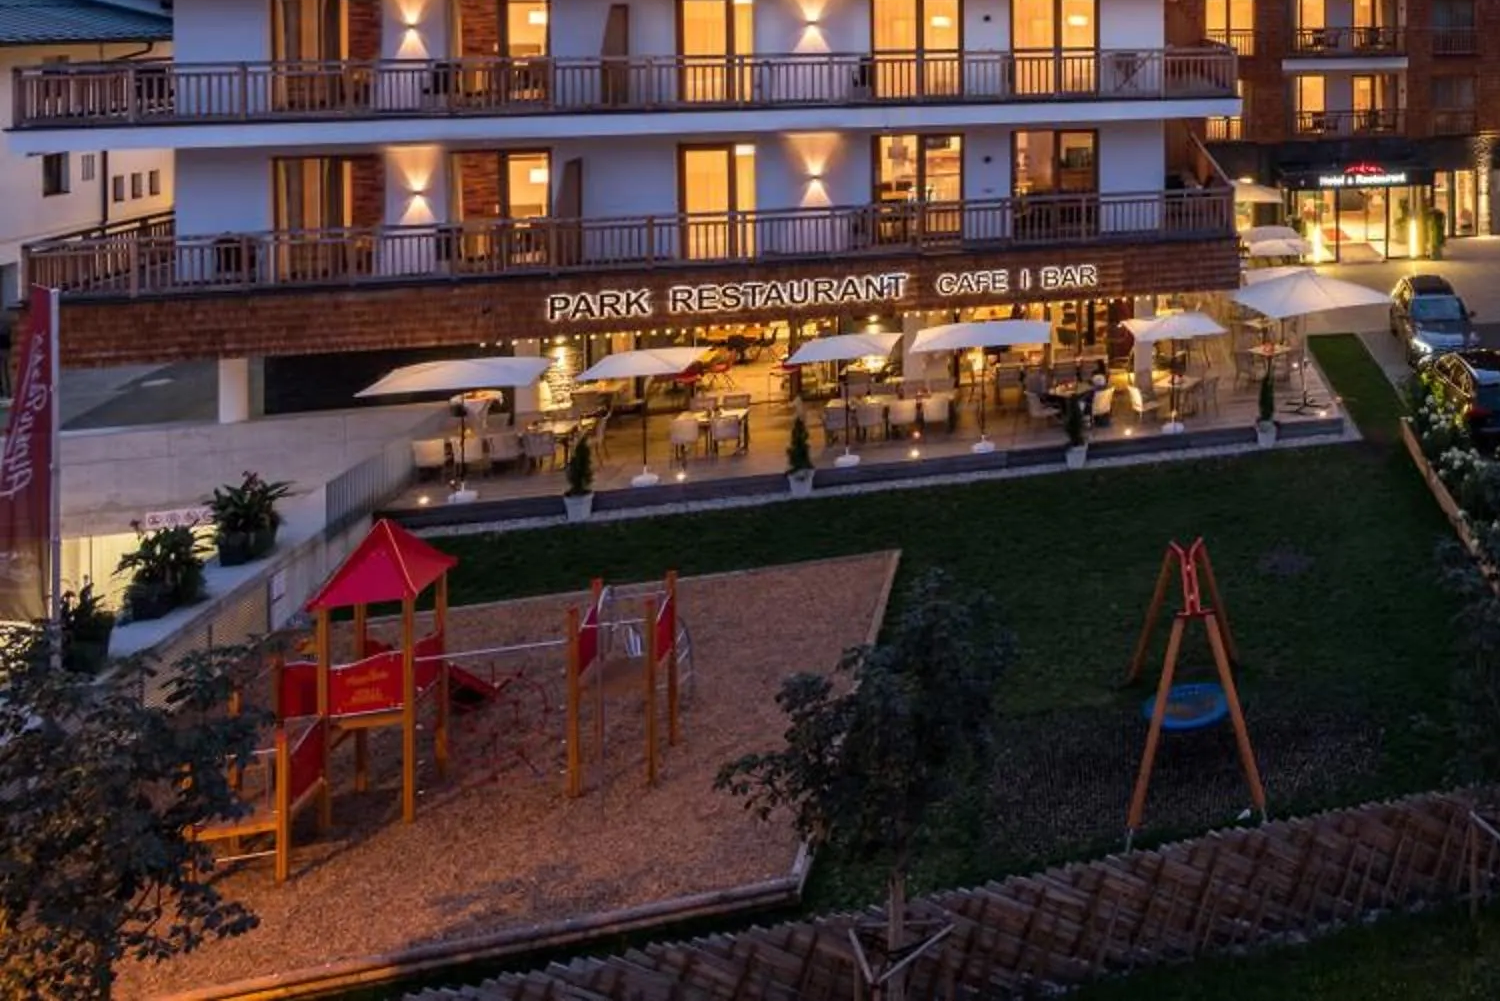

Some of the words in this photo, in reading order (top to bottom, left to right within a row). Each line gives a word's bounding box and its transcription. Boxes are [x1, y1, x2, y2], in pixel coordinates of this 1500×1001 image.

[548, 289, 650, 320] PARK
[670, 274, 909, 312] RESTAURANT
[937, 269, 1009, 296] CAFE
[1041, 264, 1097, 289] BAR
